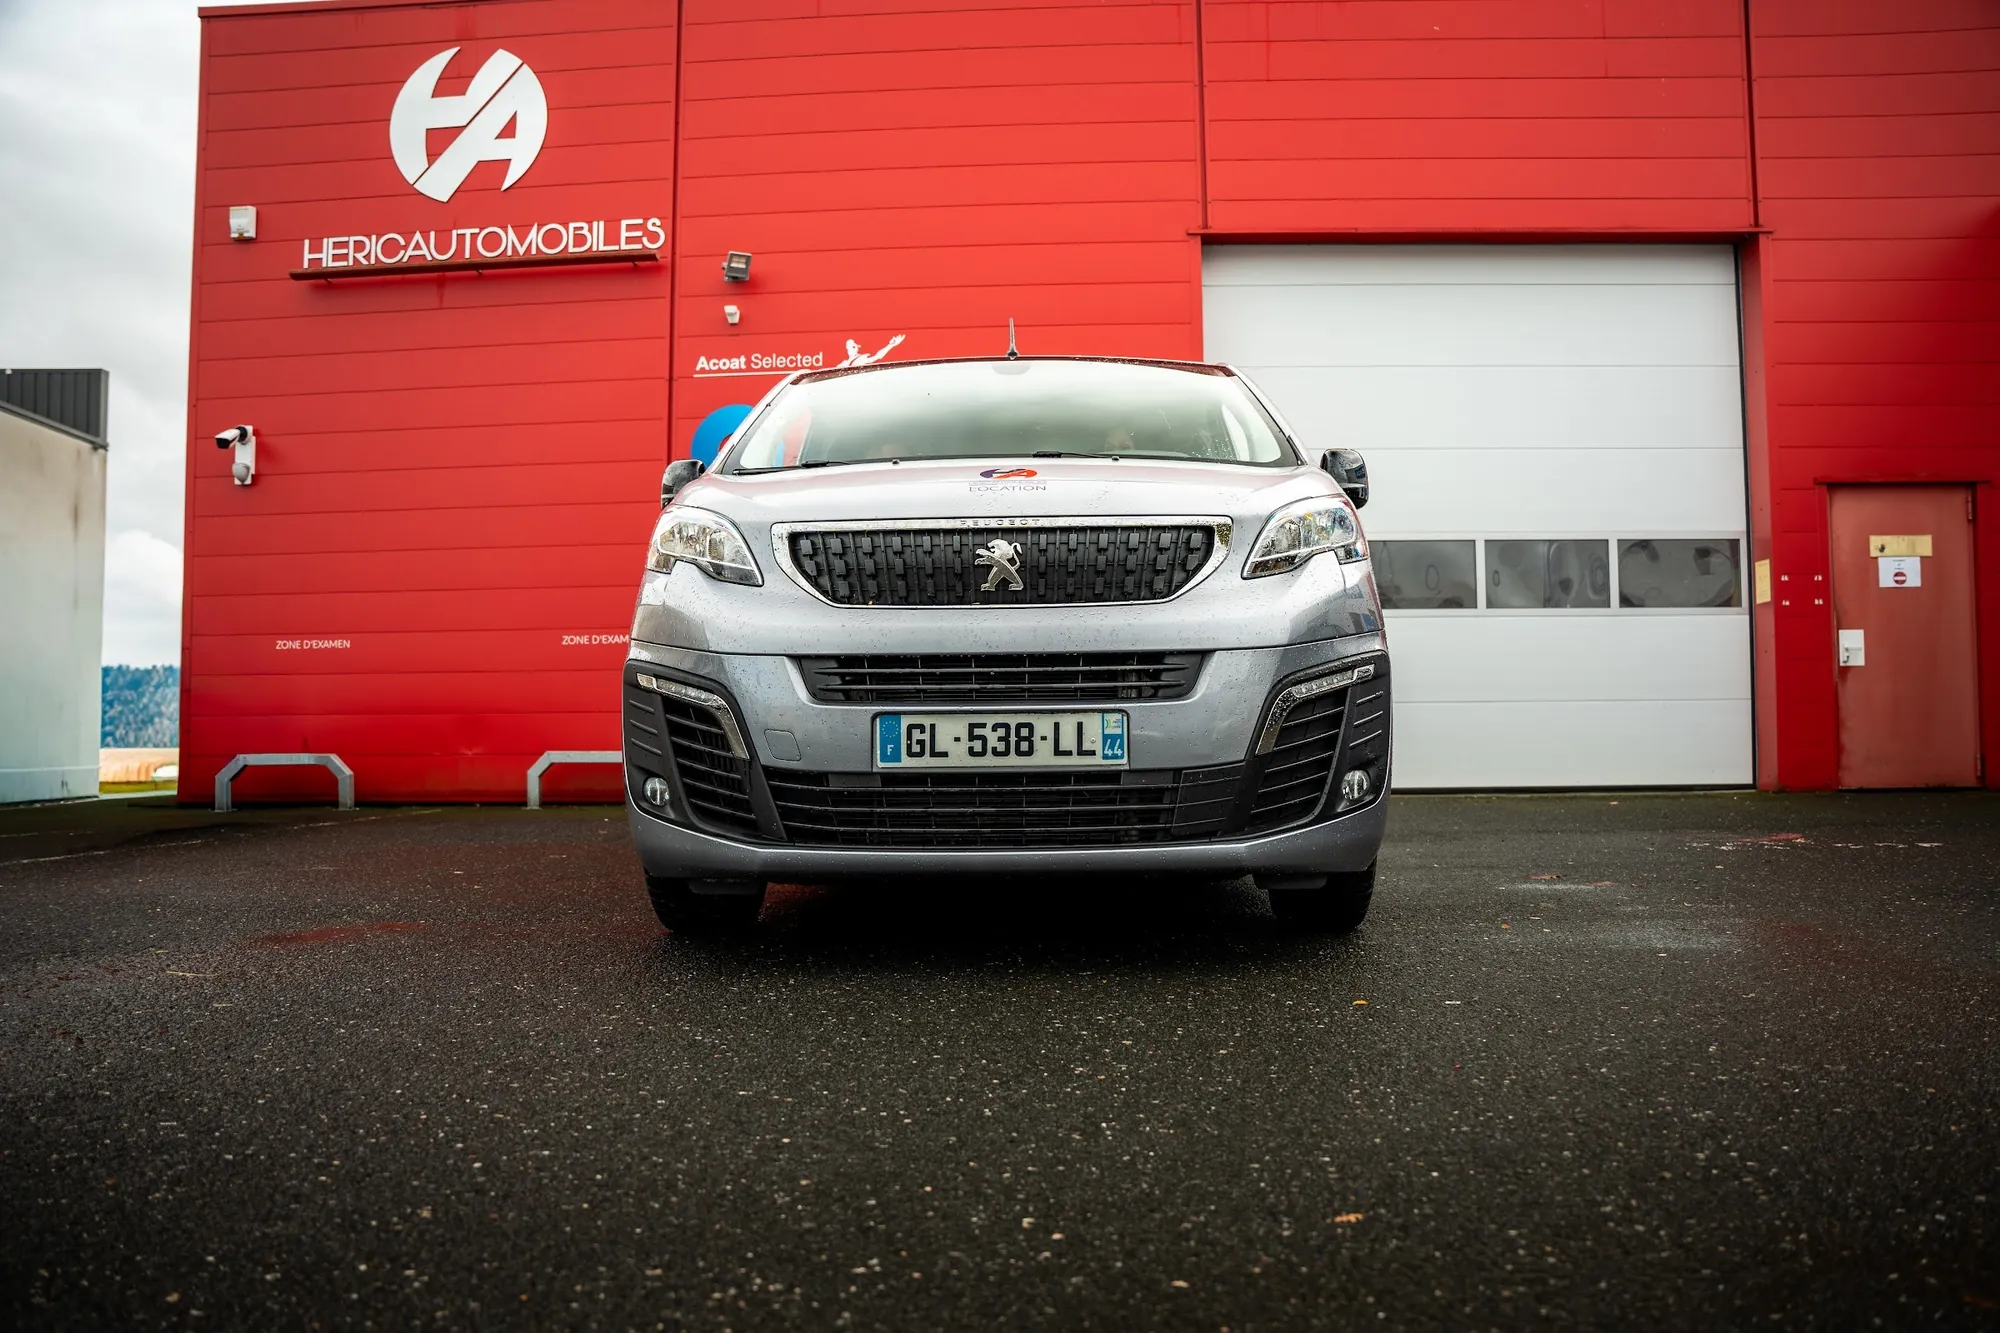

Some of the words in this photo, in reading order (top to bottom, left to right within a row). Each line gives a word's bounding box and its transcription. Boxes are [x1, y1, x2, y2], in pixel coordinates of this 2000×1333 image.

[695, 354, 747, 371] Acoat
[750, 351, 823, 368] Selected
[959, 518, 1040, 526] PEUGEOT
[275, 640, 302, 650] ZONE
[303, 639, 351, 649] D'EXAMEN
[561, 635, 590, 646] ZONE
[906, 721, 1097, 758] GL-538-LL
[887, 744, 895, 756] F
[1104, 738, 1123, 756] 44
